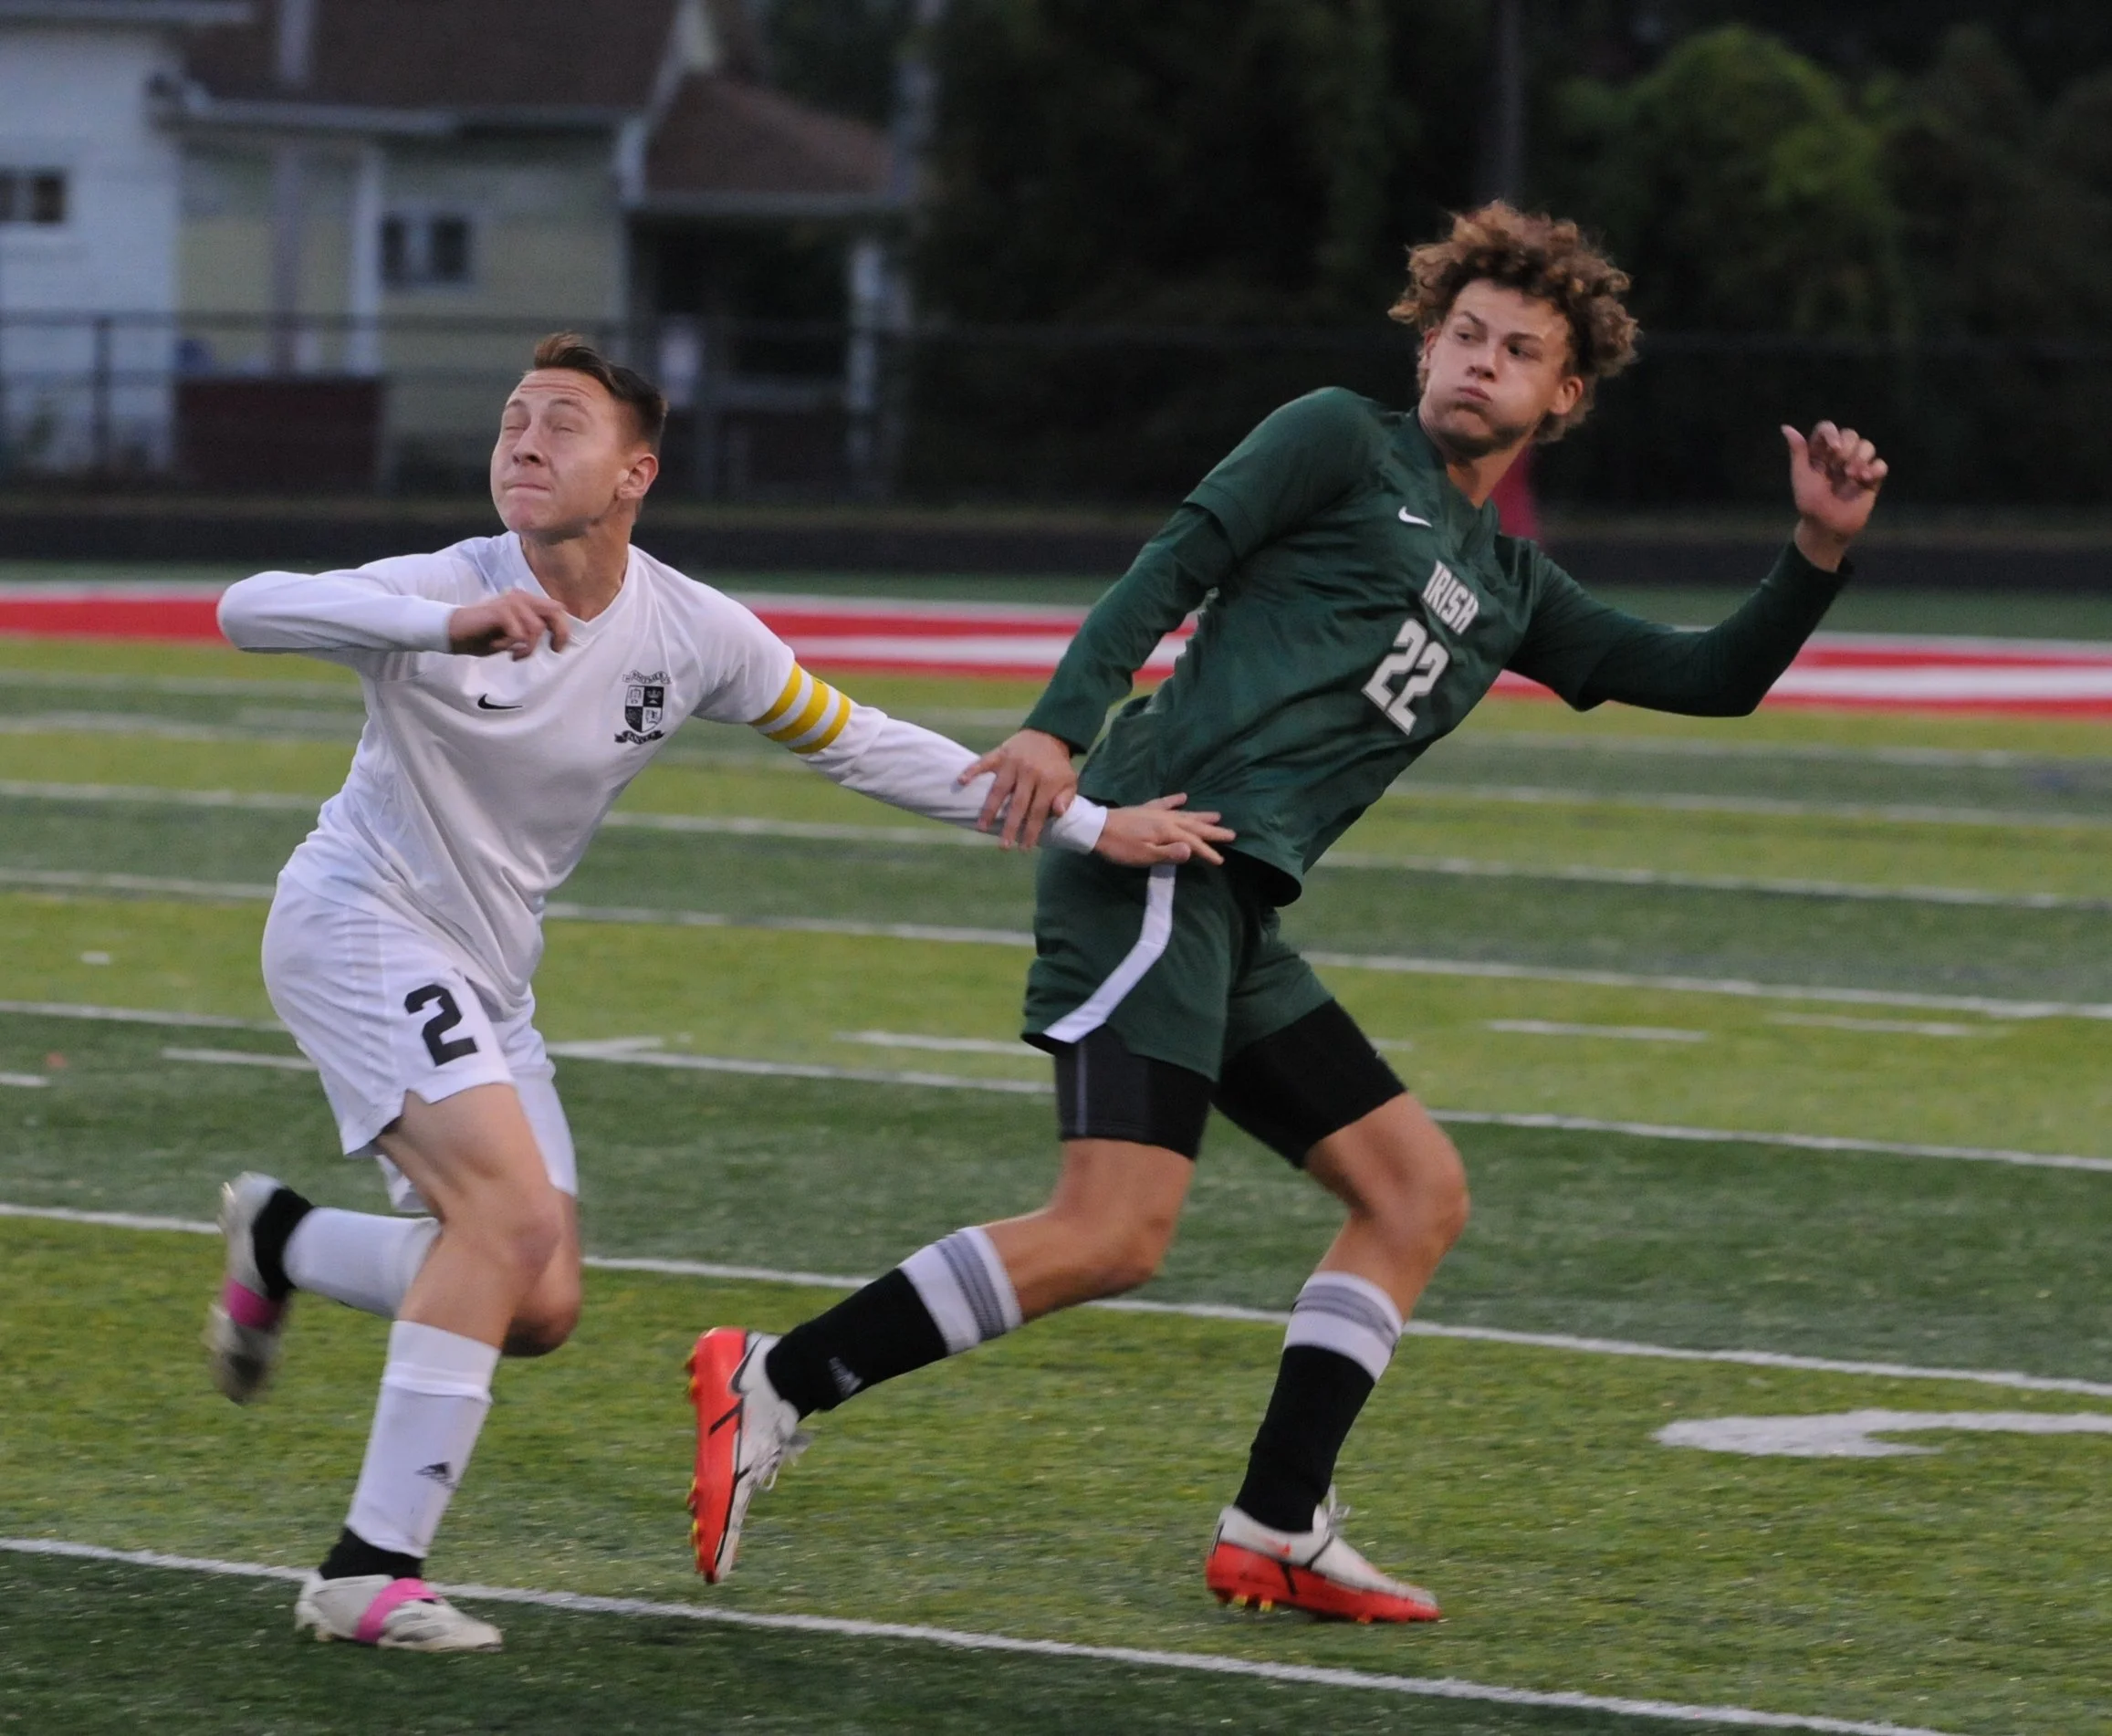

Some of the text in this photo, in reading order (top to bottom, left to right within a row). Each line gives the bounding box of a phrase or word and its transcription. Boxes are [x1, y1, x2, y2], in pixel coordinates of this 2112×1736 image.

[1422, 559, 1479, 636] IRISH
[1361, 618, 1449, 736] 22
[403, 983, 480, 1068] 2
